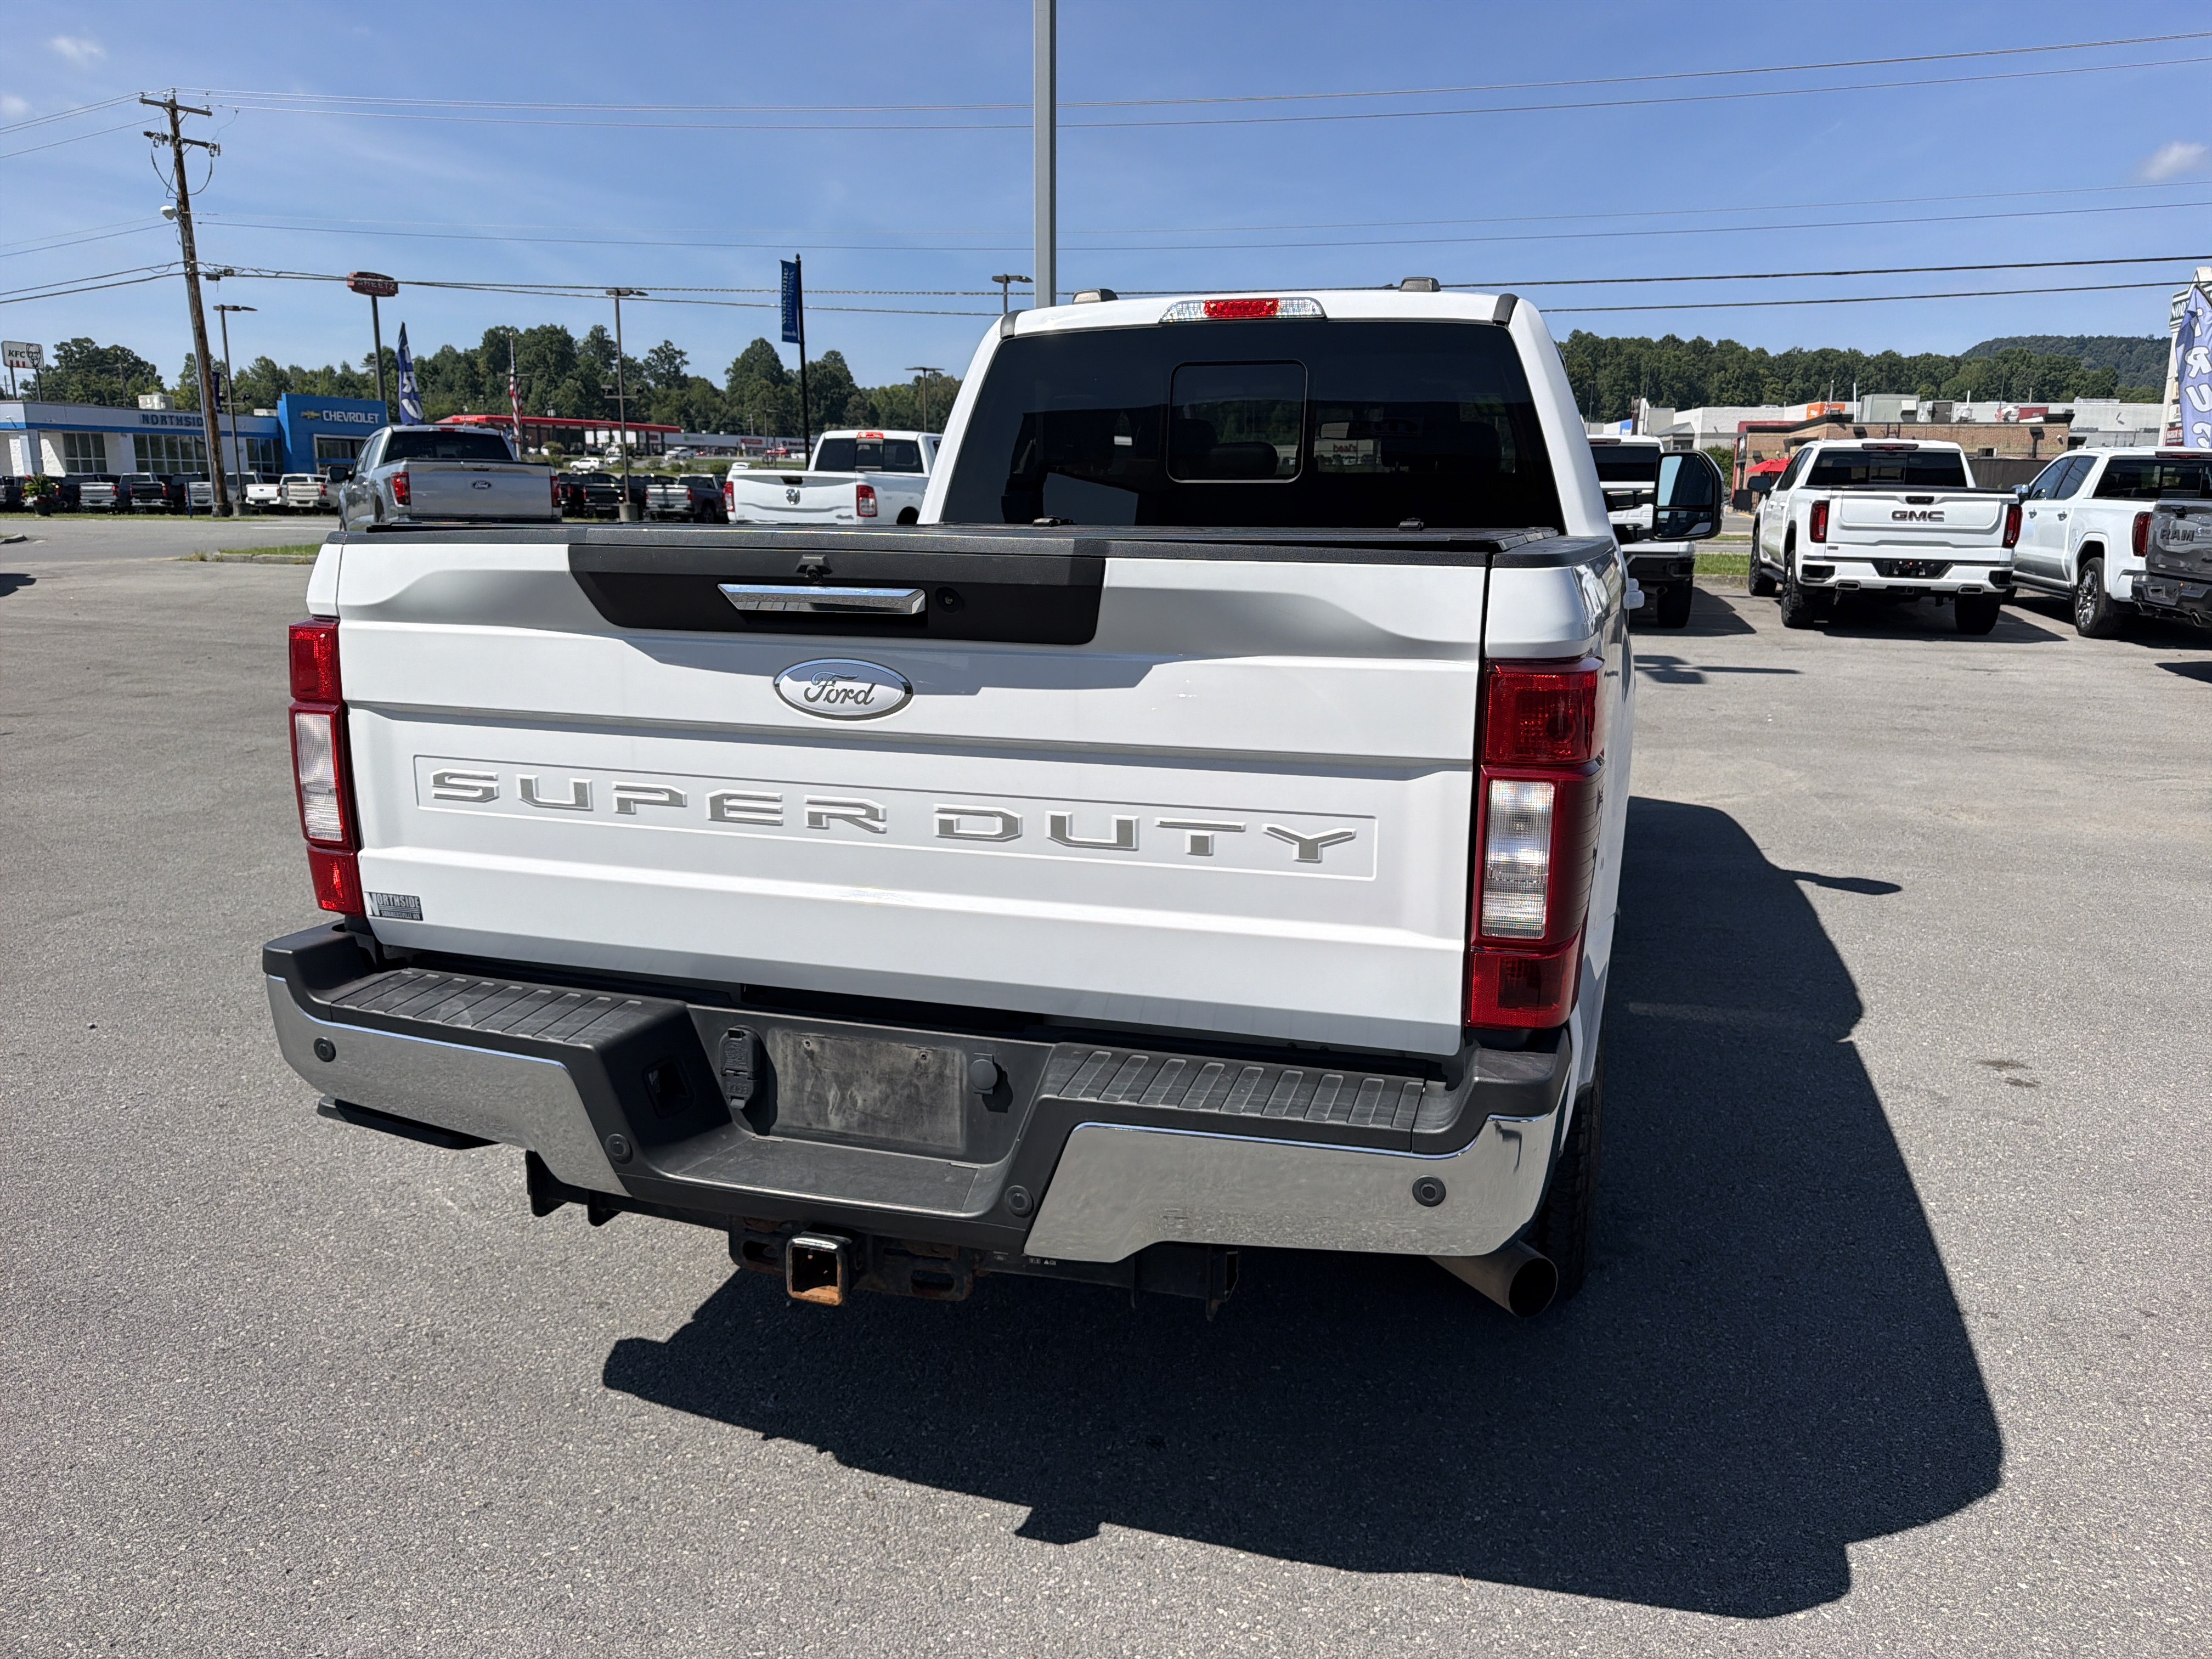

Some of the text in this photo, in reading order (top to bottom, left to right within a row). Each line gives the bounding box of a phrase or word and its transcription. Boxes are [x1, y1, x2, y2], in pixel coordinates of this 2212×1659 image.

[8, 349, 26, 358] KFC
[142, 414, 204, 426] NORTHSID
[322, 410, 379, 424] CHEVROLET
[1891, 510, 1945, 522] GMC
[2160, 529, 2195, 542] RAM
[804, 670, 877, 706] Ford
[430, 769, 1358, 864] SUPER DUTY
[363, 891, 420, 916] NORTHSIDE
